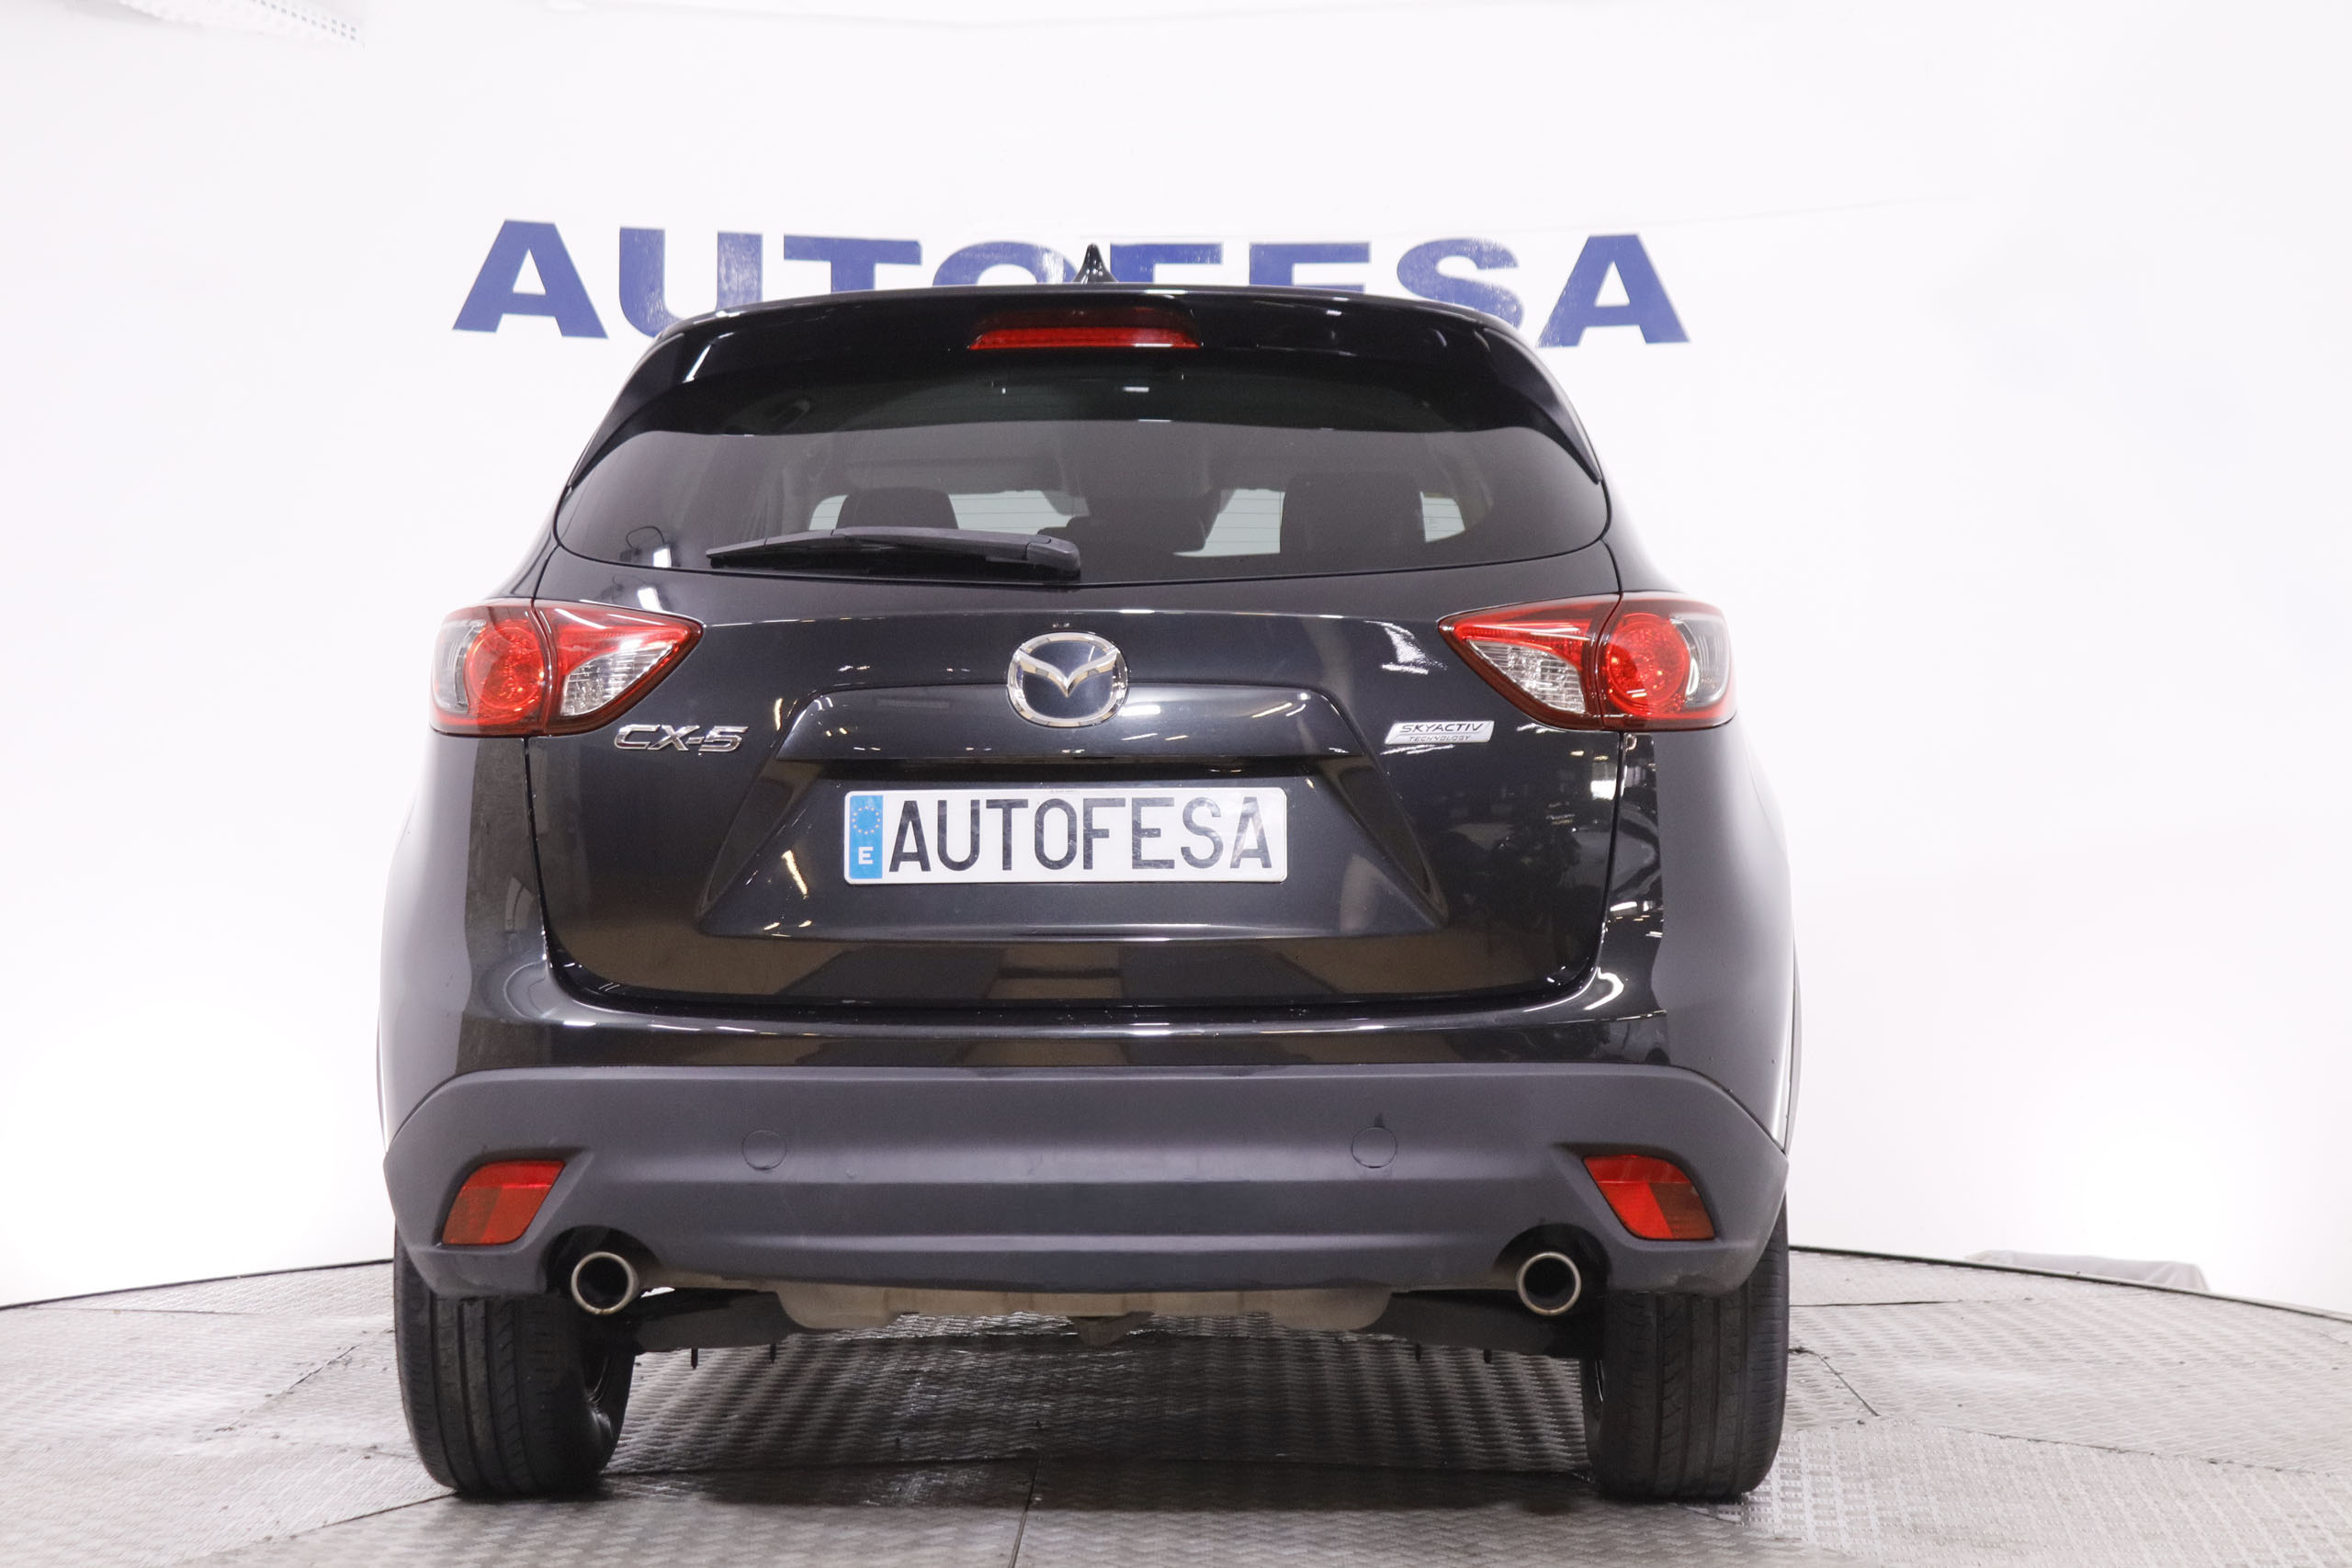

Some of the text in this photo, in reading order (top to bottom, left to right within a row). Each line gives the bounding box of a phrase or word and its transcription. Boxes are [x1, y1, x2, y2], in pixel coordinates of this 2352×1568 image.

[614, 724, 750, 752] CX-5
[1399, 722, 1484, 733] SKYACTIV
[888, 796, 1272, 873] AUTOFESA
[857, 846, 874, 865] E
